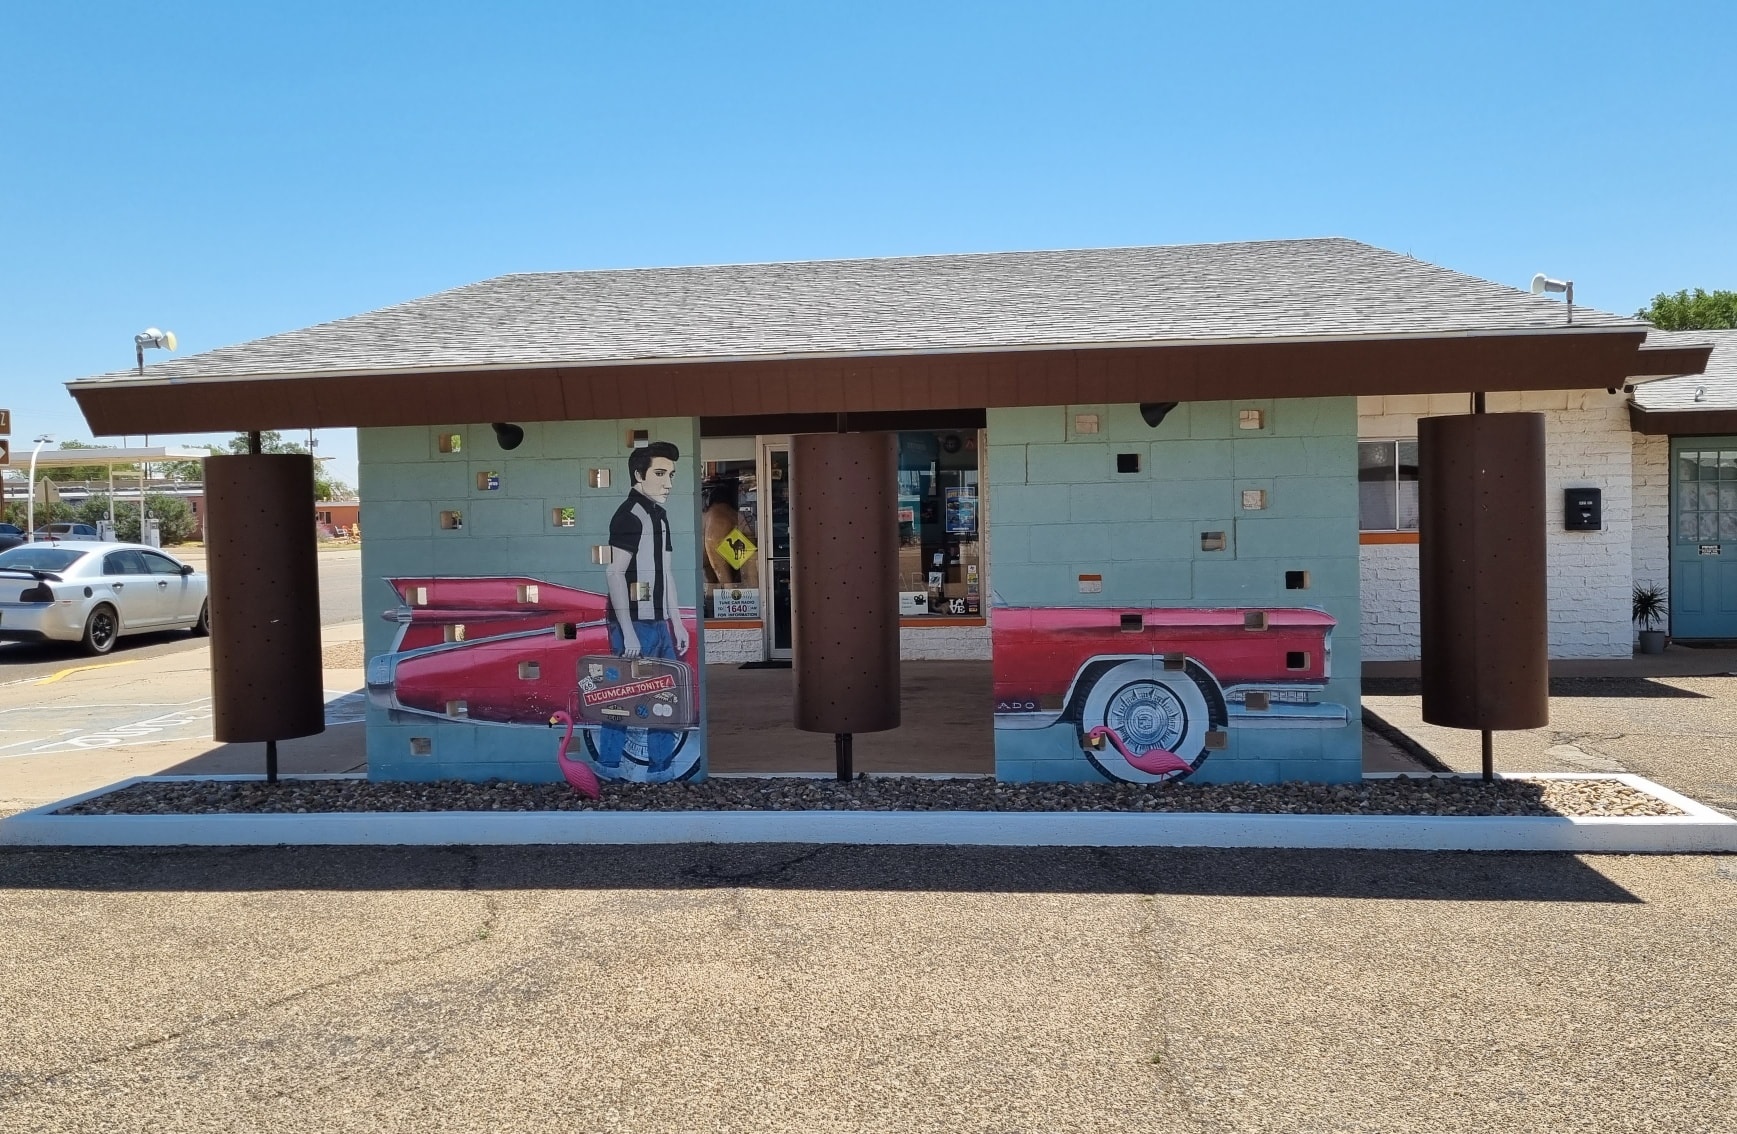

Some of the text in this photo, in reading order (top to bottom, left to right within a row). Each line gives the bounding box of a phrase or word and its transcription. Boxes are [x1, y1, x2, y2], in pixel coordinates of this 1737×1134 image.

[726, 604, 748, 612] 1640
[586, 686, 635, 702] TUCUMCARI
[997, 702, 1035, 710] ADO
